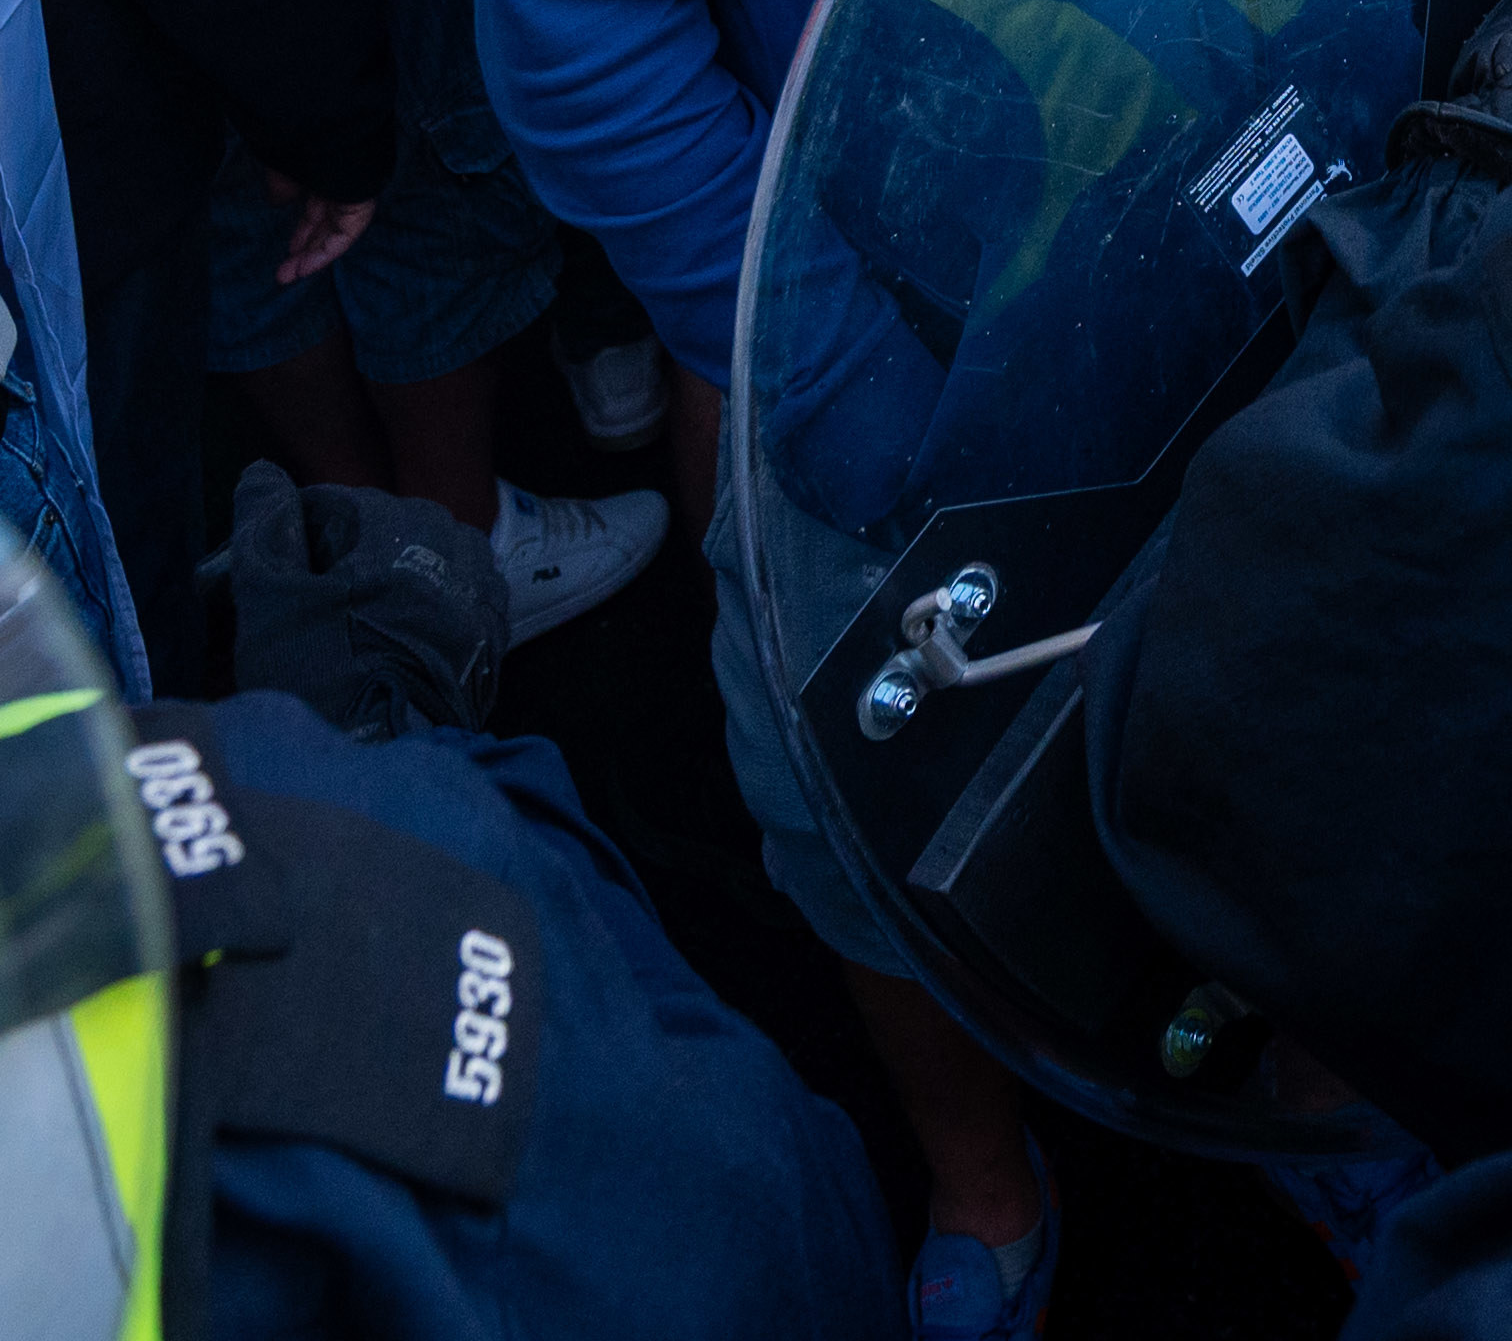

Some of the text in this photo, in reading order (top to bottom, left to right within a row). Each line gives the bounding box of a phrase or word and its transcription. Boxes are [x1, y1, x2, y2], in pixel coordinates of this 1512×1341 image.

[1263, 212, 1295, 249] Protective
[1244, 245, 1266, 271] Shield
[443, 928, 515, 1107] 5930
